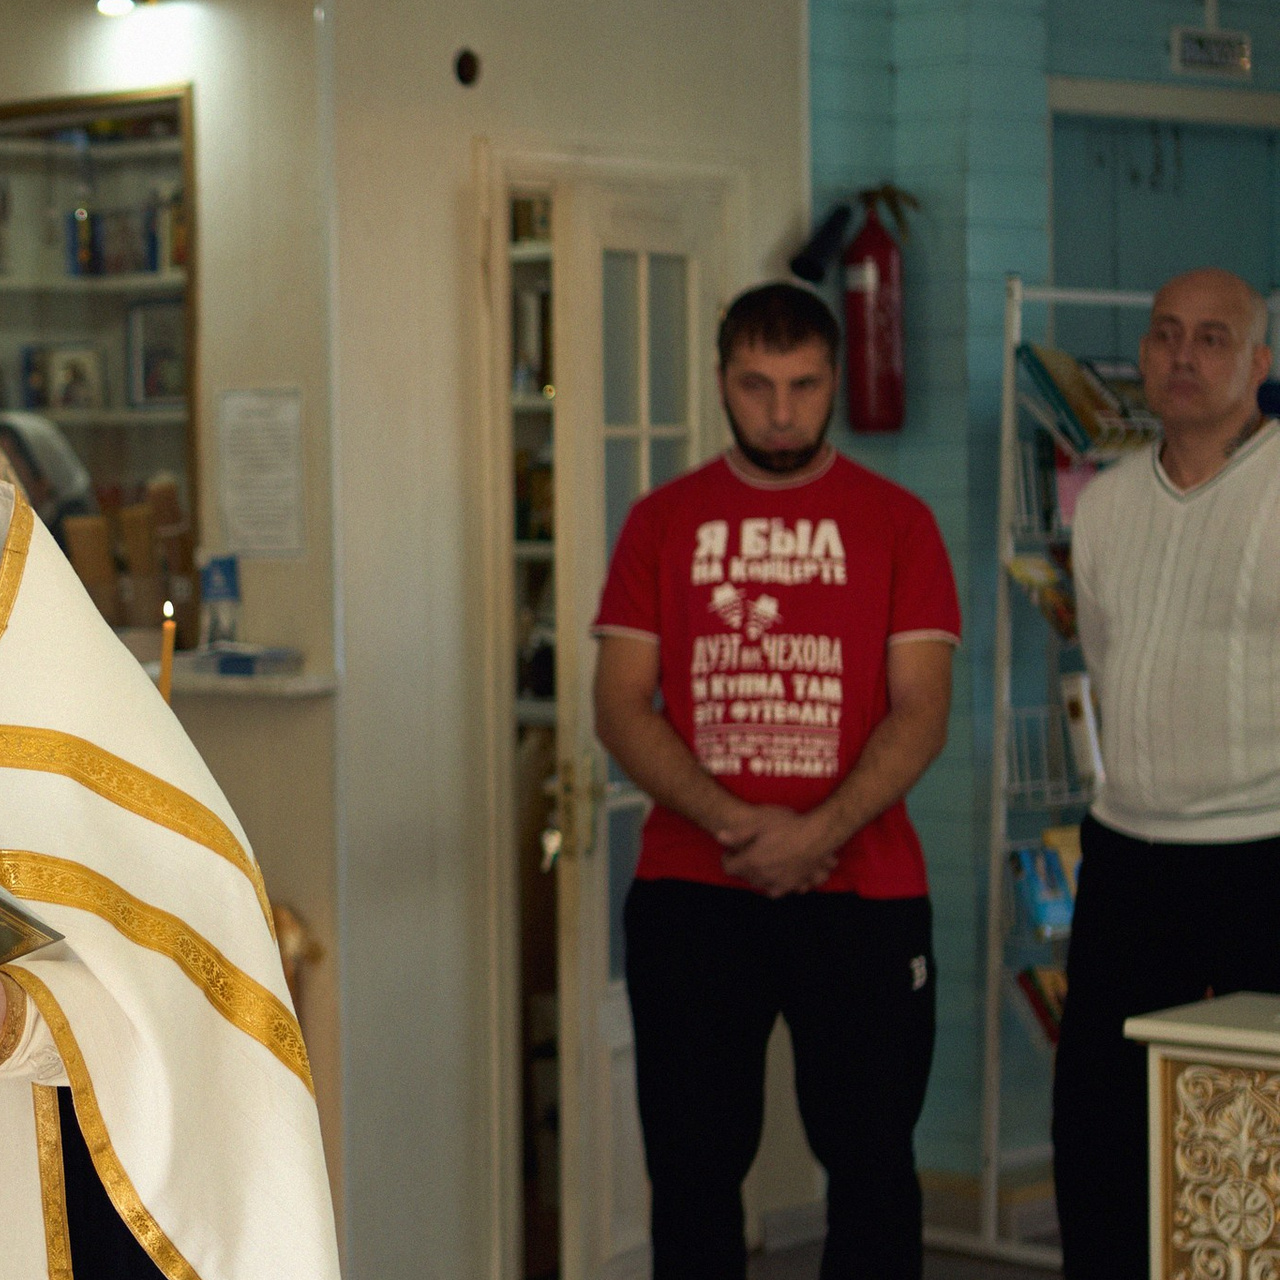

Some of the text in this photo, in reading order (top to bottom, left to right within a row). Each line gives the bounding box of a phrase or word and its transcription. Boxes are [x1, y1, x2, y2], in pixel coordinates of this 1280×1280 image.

[695, 517, 846, 559] Я БЫЛ
[691, 558, 724, 586] НА
[691, 633, 742, 674] ДУЭТ
[761, 632, 844, 675] ЧЕХОВА
[791, 674, 844, 703] ТАМ
